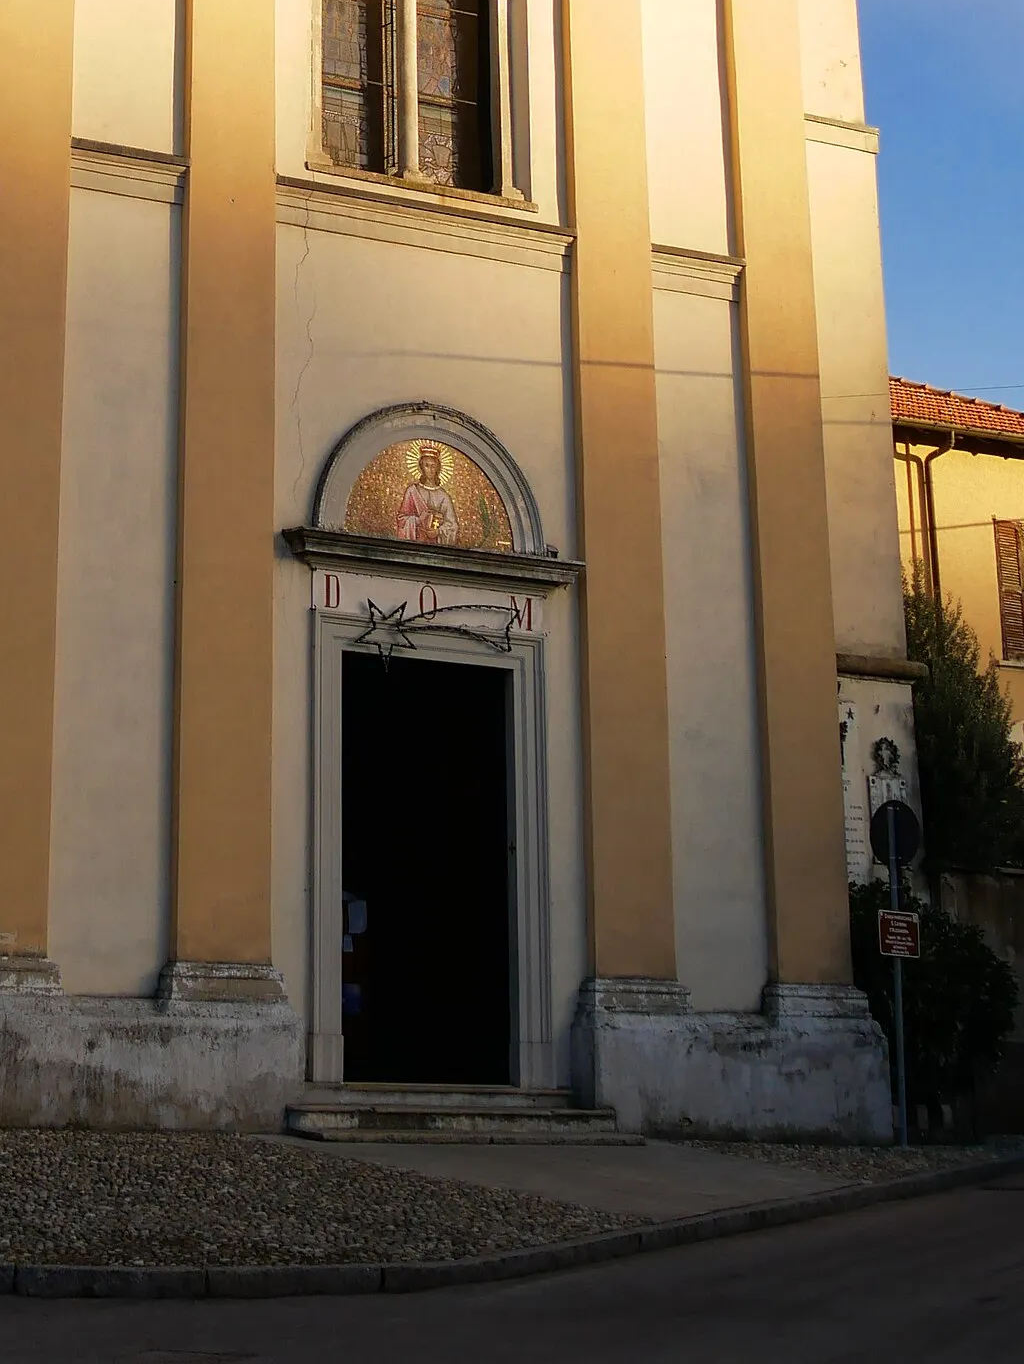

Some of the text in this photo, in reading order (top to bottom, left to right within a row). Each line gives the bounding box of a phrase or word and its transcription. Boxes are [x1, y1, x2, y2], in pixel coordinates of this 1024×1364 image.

[324, 573, 533, 632] D O M
